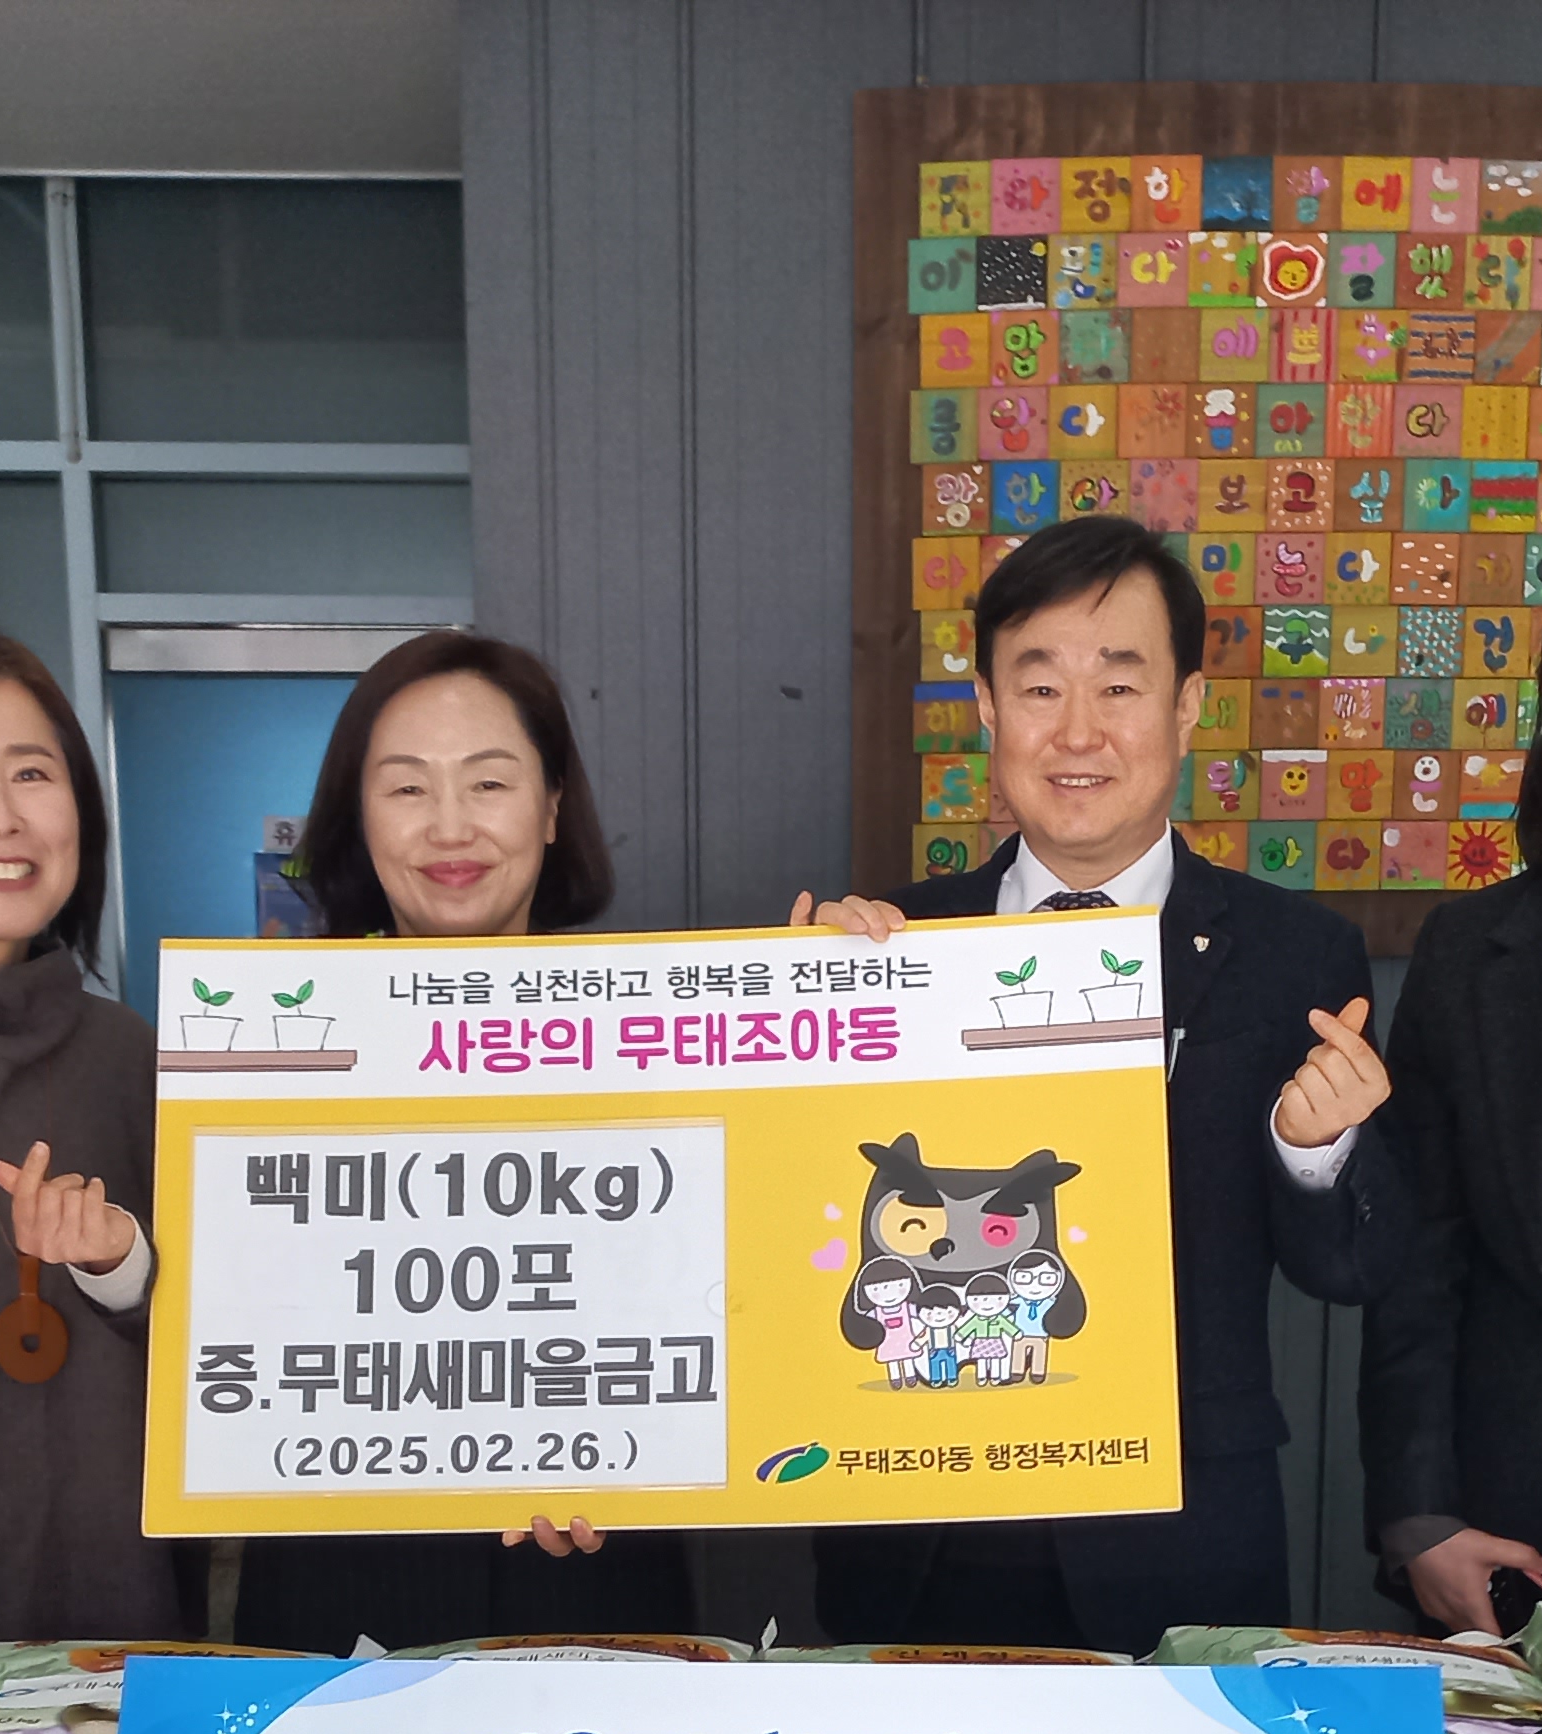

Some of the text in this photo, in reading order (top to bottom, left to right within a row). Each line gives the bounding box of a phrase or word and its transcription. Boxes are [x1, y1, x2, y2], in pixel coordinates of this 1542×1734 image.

[389, 956, 933, 1006] 나눔을 실천하고 행복을 전달하는
[419, 1005, 901, 1073] 사랑의 무태조야동
[245, 1146, 674, 1223] 백미(10kg)
[342, 1244, 577, 1316] 100포
[195, 1334, 718, 1414] 증.무태새마을금고
[273, 1428, 639, 1478] (2025.02.26.)
[835, 1436, 1149, 1476] 무태조야동 행정복지센터
